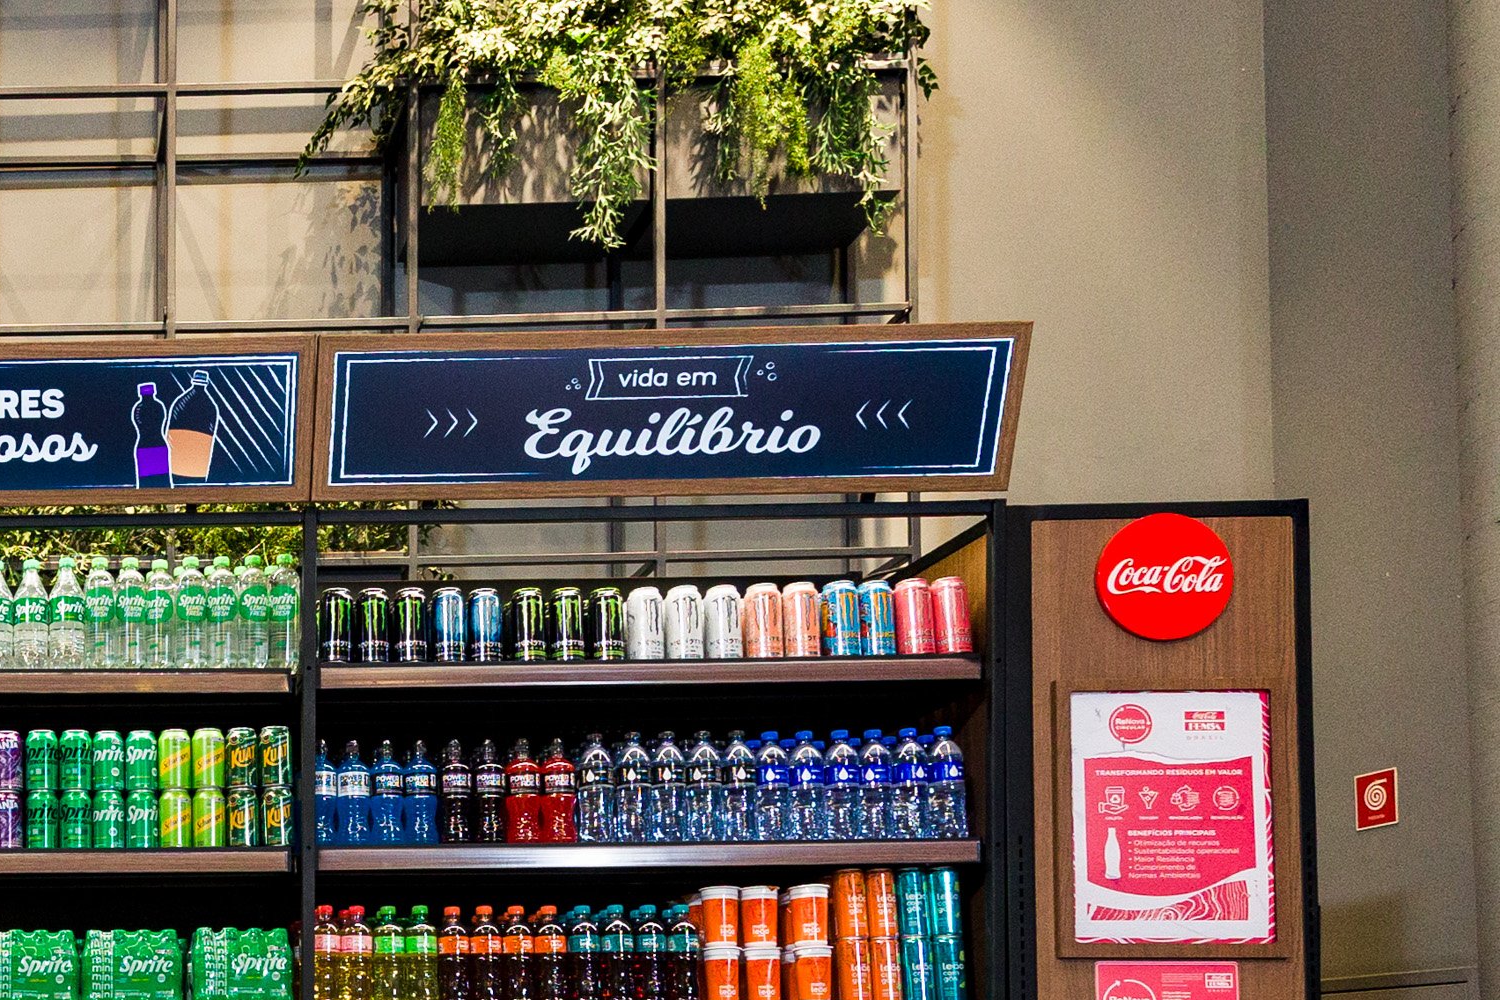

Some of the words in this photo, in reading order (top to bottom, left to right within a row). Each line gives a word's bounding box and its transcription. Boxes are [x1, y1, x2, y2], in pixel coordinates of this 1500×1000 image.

[618, 367, 669, 387] vida
[677, 369, 717, 386] em
[524, 407, 821, 475] Equilíbrio
[1107, 556, 1227, 595] Coca-Cola
[18, 956, 71, 974] Sprite
[119, 955, 173, 973] Sprite
